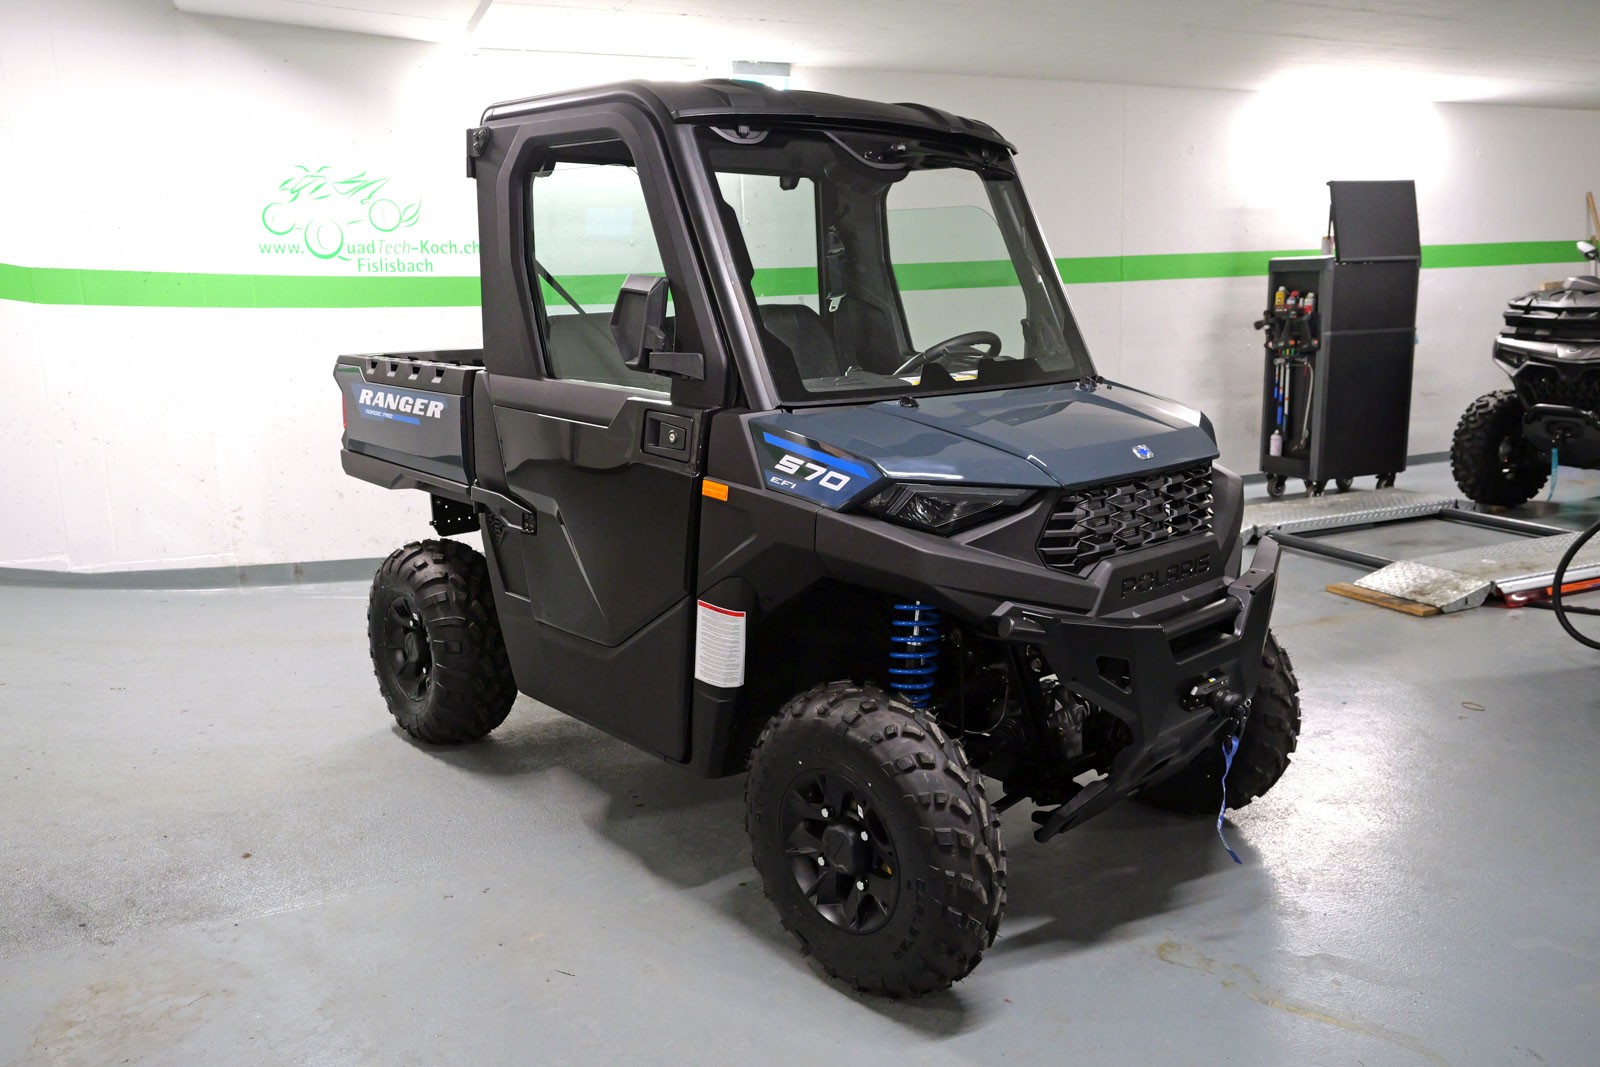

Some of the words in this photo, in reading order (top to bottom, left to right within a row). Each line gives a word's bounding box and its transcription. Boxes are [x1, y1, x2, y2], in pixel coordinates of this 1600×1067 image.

[357, 258, 433, 273] Fislisbach
[359, 388, 444, 419] RANGER
[770, 476, 797, 489] EFI
[774, 454, 851, 492] 570
[1121, 554, 1211, 599] POLARIS
